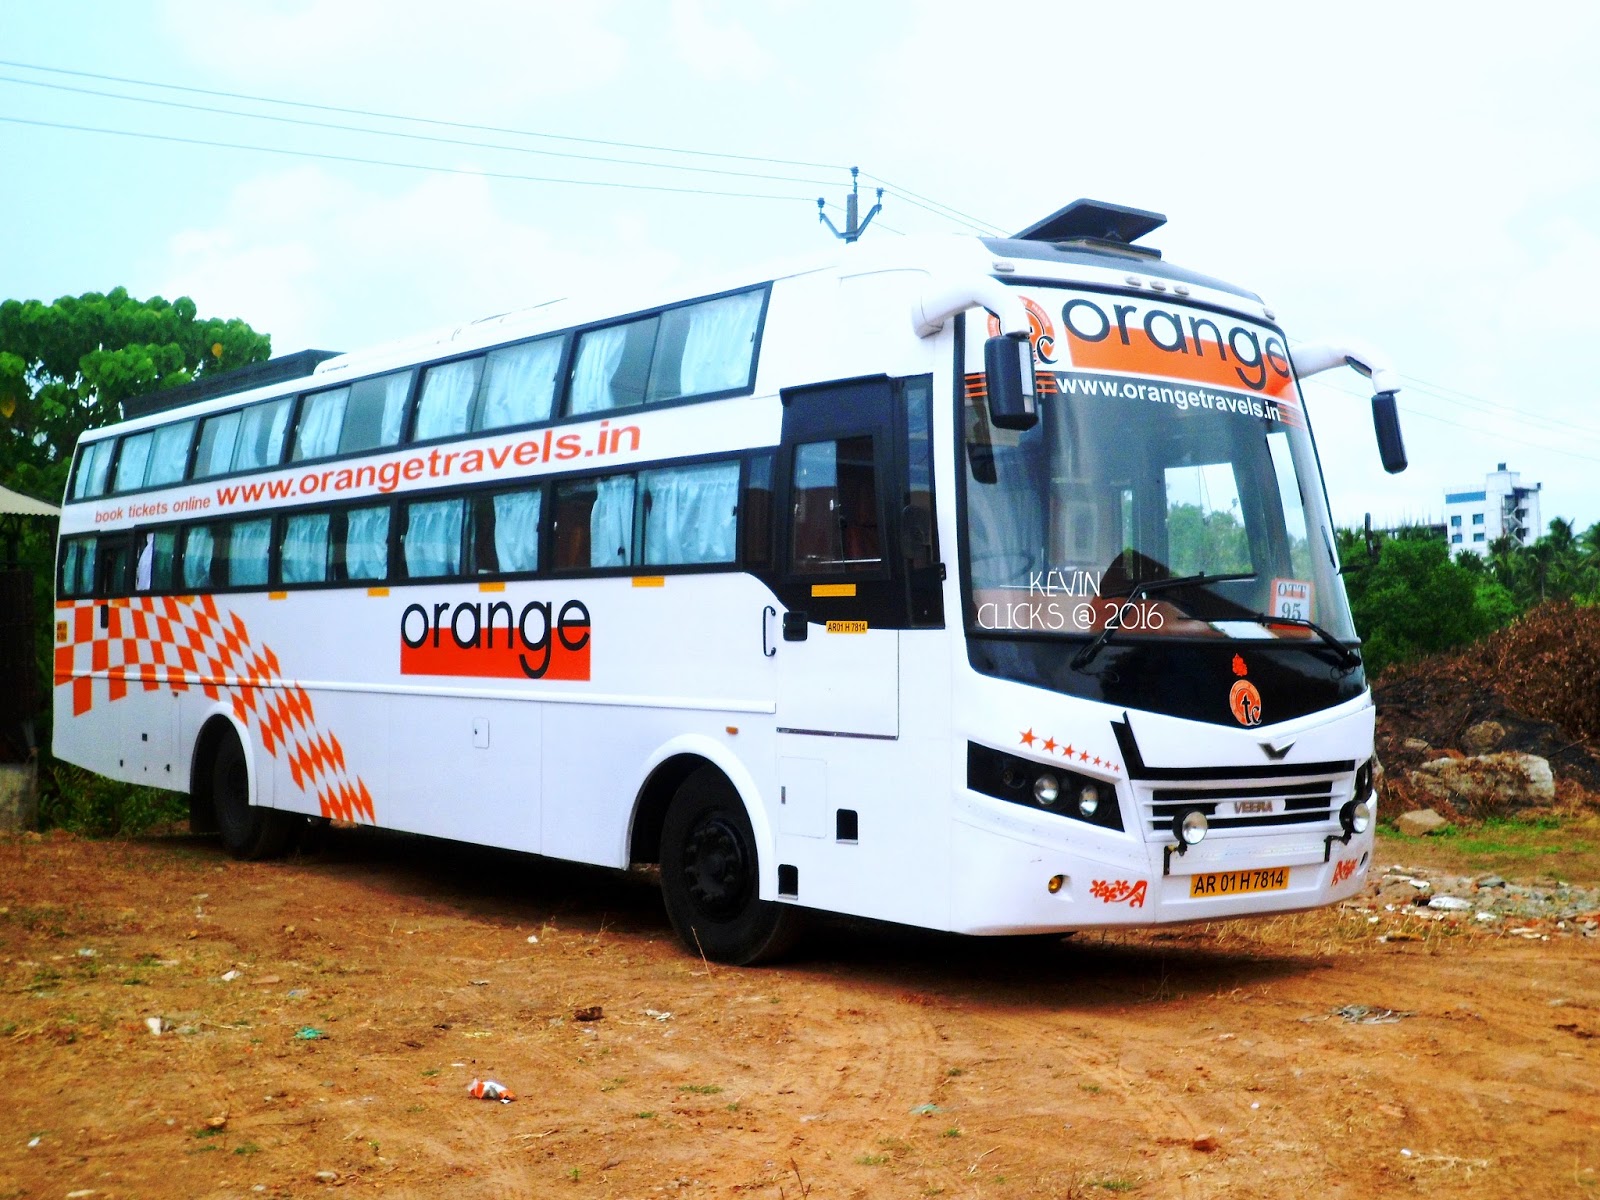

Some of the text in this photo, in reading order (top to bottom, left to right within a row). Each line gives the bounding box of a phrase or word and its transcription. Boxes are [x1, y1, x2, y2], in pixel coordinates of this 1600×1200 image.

[1061, 299, 1290, 391] orange
[1056, 378, 1281, 422] www.orangetravels.in
[95, 421, 641, 523] book tickets online www.orangetravels.in
[401, 599, 591, 679] orange
[1281, 602, 1302, 620] 95
[1194, 869, 1284, 895] AR 01 H 7814
